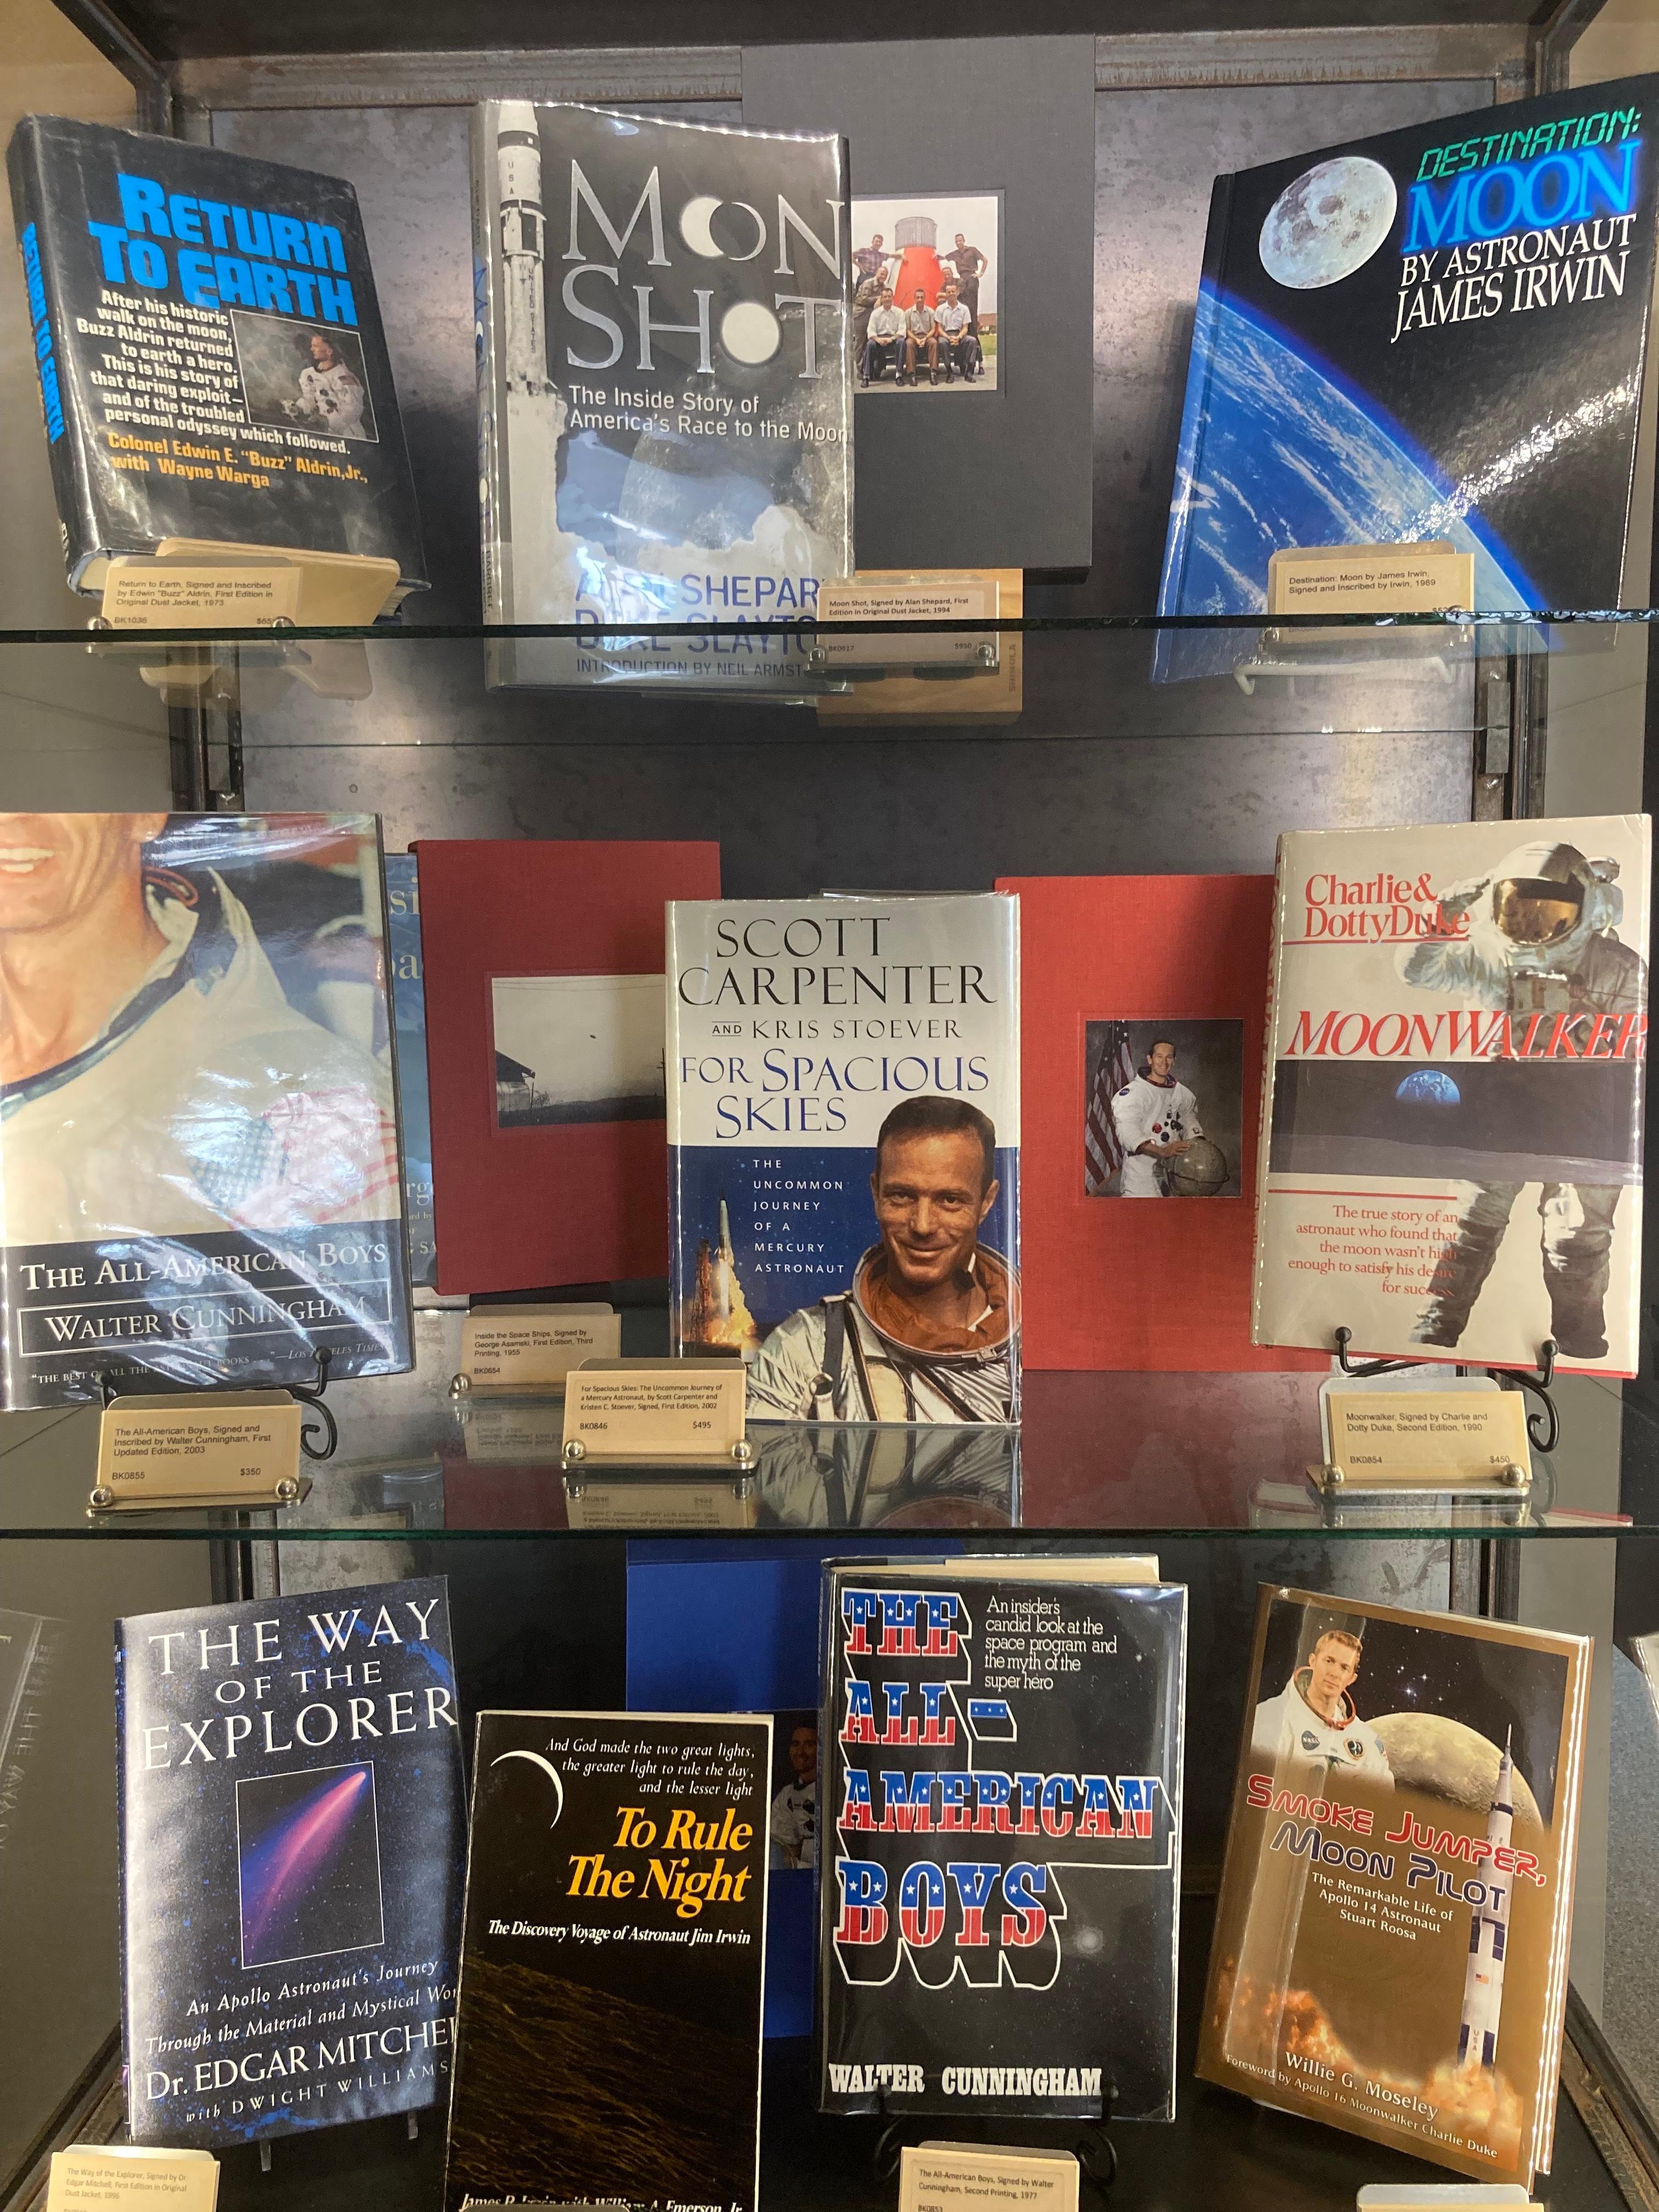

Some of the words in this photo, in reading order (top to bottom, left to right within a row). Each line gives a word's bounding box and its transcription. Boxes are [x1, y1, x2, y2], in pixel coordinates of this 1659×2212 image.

[1417, 107, 1641, 182] DESTINATION:
[1402, 140, 1640, 252] MOON
[117, 173, 347, 274] RETURN
[562, 160, 844, 279] MOON
[1401, 251, 1438, 286] BY
[1443, 213, 1637, 278] ASTRONAUT
[88, 222, 168, 290] TO
[177, 250, 358, 326] EARTH
[102, 290, 143, 311] After
[146, 294, 168, 315] his
[170, 297, 229, 326] historic
[1391, 273, 1503, 343] JAMES
[1510, 251, 1629, 312] IRWIN
[97, 307, 134, 326] walk
[137, 314, 157, 329] on
[160, 315, 184, 333] the
[187, 320, 232, 343] moon,
[562, 264, 841, 379] SHOT
[569, 385, 606, 405] The
[614, 388, 675, 409] Inside
[683, 393, 733, 416] Story
[741, 396, 759, 414] of
[570, 410, 670, 432] America's
[679, 416, 726, 435] Race
[735, 419, 752, 436] to
[760, 420, 789, 438] the
[186, 581, 214, 590] Signed
[1289, 586, 1317, 594] Signed
[716, 917, 890, 957] SCOTT
[679, 965, 997, 1006] CARPENTER
[713, 1025, 741, 1034] AND
[753, 1020, 819, 1039] KRIS
[833, 1020, 962, 1039] STOEVER
[1284, 1011, 1647, 1059] MOONWALKER
[682, 1057, 753, 1084] FOR
[763, 1048, 989, 1092] SPACIOUS
[716, 1096, 847, 1138] SKIES
[754, 1160, 782, 1168] THE
[754, 1181, 843, 1190] UNCOMMON
[754, 1202, 820, 1211] JOURNEY
[755, 1222, 771, 1231] OF
[783, 1222, 791, 1231] A
[1333, 1205, 1358, 1218] The
[1361, 1209, 1387, 1220] true
[1391, 1211, 1422, 1225] story
[1426, 1210, 1441, 1222] of
[1443, 1215, 1457, 1223] an
[20, 1264, 86, 1290] THE
[95, 1250, 305, 1285] ALL-AMERICAN
[317, 1243, 386, 1267] BOYS
[755, 1244, 824, 1252] MERCURY
[755, 1265, 844, 1273] ASTRONAUT
[45, 1314, 163, 1342] WALTER
[172, 1296, 364, 1330] CUNNINGHAM
[509, 1331, 529, 1339] Space
[554, 1330, 577, 1338] Signed
[586, 1393, 611, 1402] Mercury
[647, 1393, 655, 1402] by
[674, 1393, 703, 1402] Carpenter
[1400, 1413, 1426, 1421] Signed
[693, 1421, 711, 1429] $495
[114, 1448, 148, 1457] Updated
[151, 1447, 182, 1455] Edition,
[843, 1589, 958, 1656] THE
[986, 1598, 1008, 1613] An
[1011, 1596, 1060, 1615] insider's
[149, 1619, 282, 1675] THE
[308, 1599, 439, 1654] WAY
[216, 1676, 271, 1703] OF
[291, 1661, 382, 1693] THE
[142, 1688, 457, 1770] EXPLORER
[640, 1782, 660, 1793] and
[667, 1782, 684, 1794] the
[689, 1782, 720, 1795] lesser
[726, 1782, 753, 1801] light
[838, 1769, 1158, 1838] AMERICAN
[613, 1807, 656, 1848] To
[661, 1808, 752, 1850] Rule
[1246, 1774, 1373, 1835] SMOKE
[1385, 1812, 1545, 1887] JUMPER,
[566, 1854, 634, 1897] The
[638, 1857, 752, 1918] Night
[1270, 1821, 1394, 1880] MOON
[1407, 1853, 1505, 1911] PILOT
[833, 1857, 1046, 1946] BOYS
[1319, 1889, 1358, 1909] Apollo
[1363, 1902, 1376, 1914] 14
[1381, 1905, 1441, 1933] Astronaut
[489, 1920, 509, 1935] The
[511, 1921, 568, 1943] Discovery
[572, 1924, 610, 1945] Voyage
[613, 1925, 629, 1940] of
[629, 1926, 689, 1943] Astronaut
[690, 1928, 713, 1945] Jim
[716, 1929, 750, 1944] Irwin
[146, 2073, 188, 2101] Dr.
[195, 2046, 309, 2092] EDGAR
[828, 2063, 924, 2092] WALTER
[941, 2066, 1102, 2096] CUNNINGHAM
[1285, 2051, 1335, 2081] Willie
[1342, 2073, 1358, 2090] G.
[1365, 2081, 1438, 2121] Moseley
